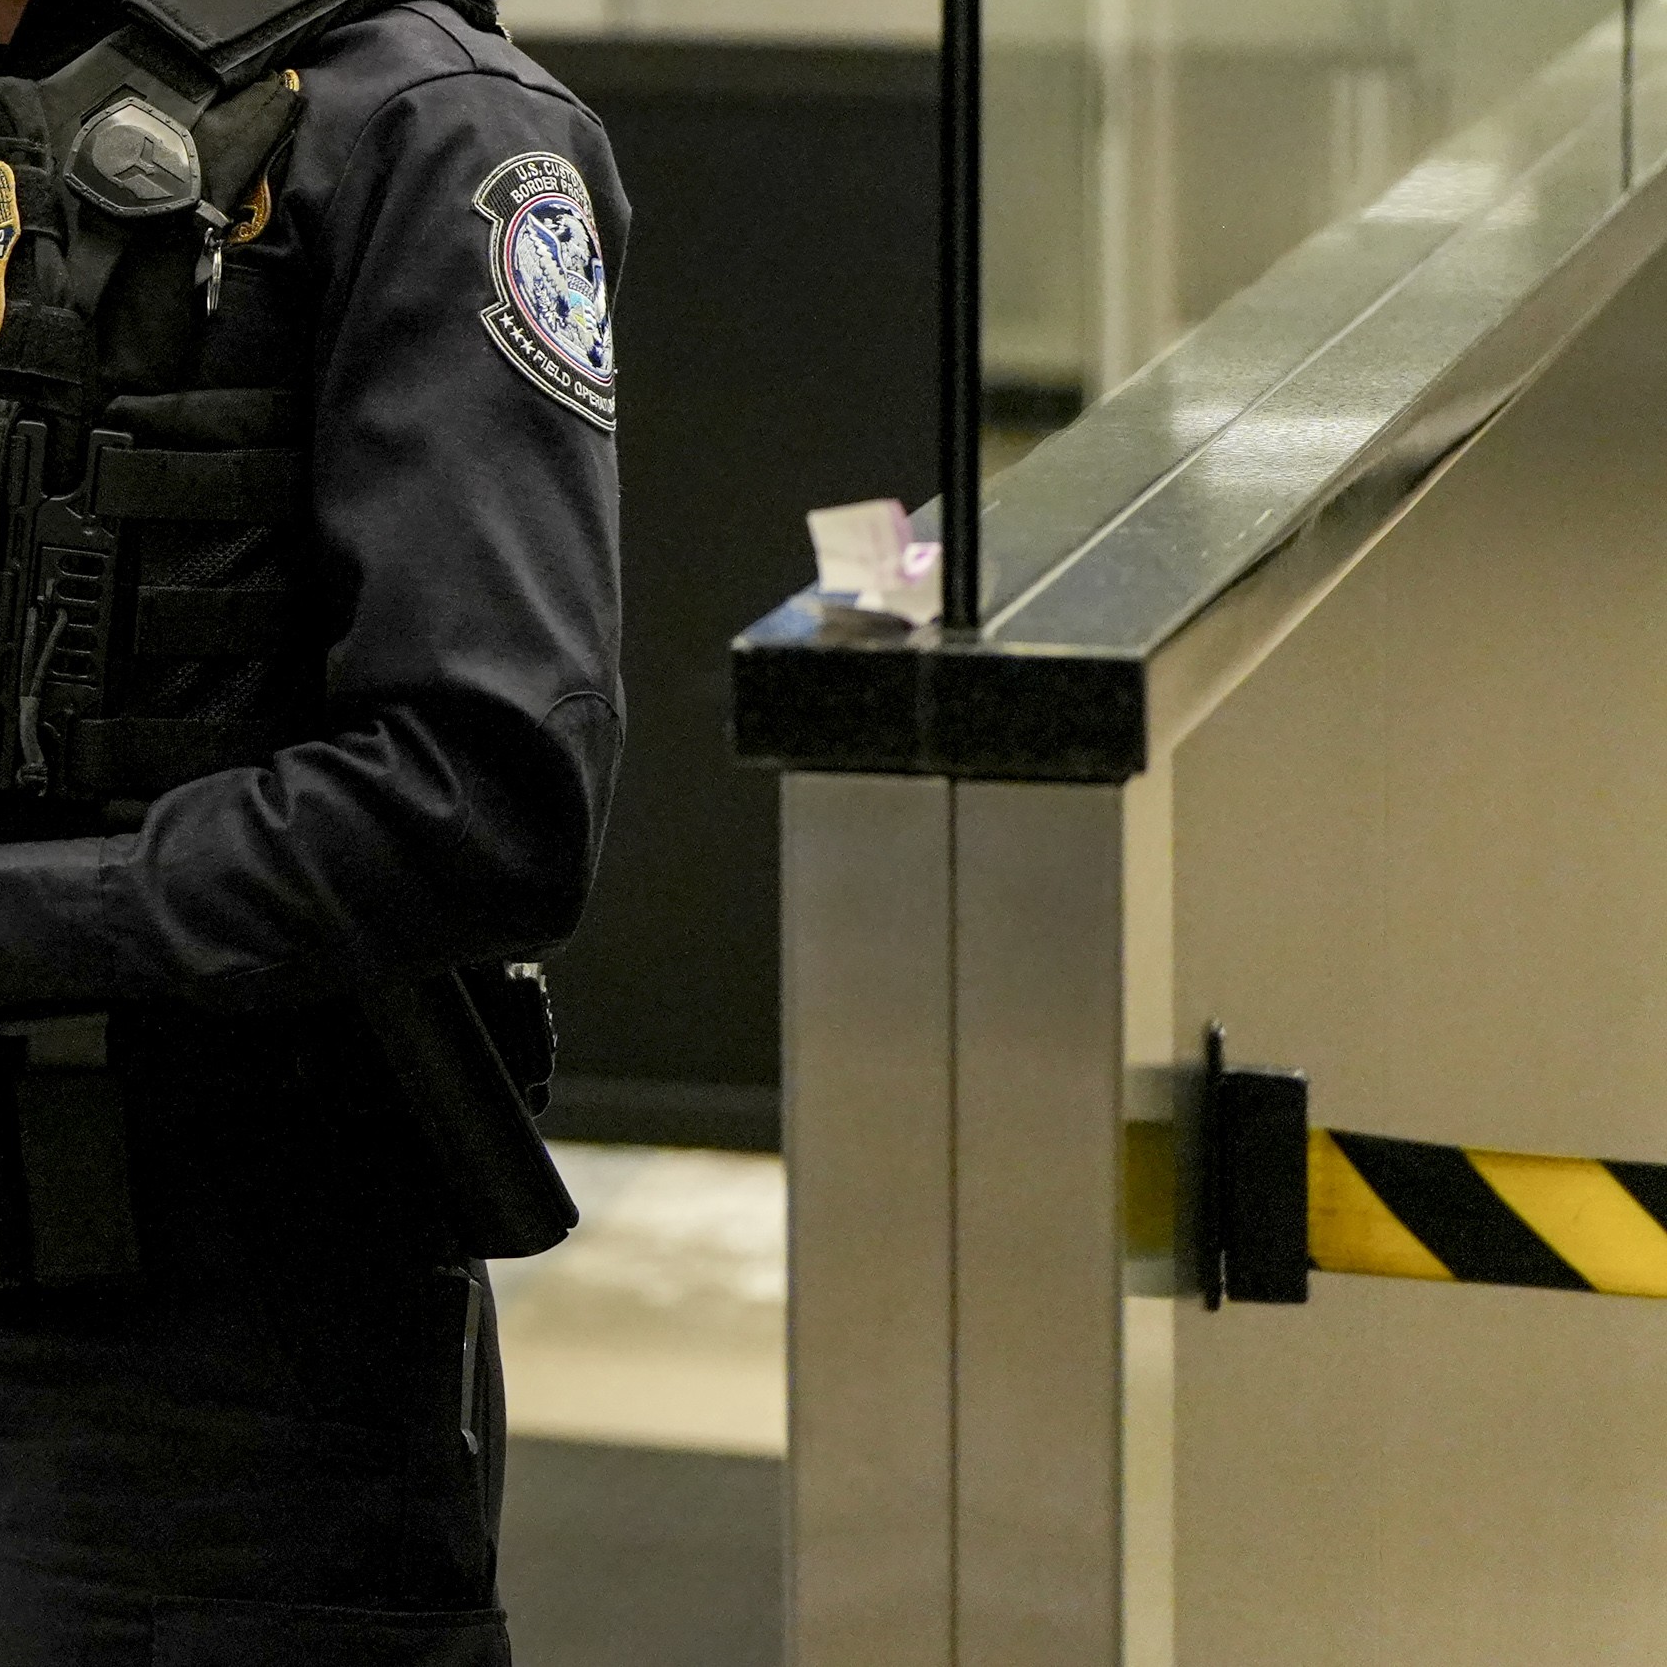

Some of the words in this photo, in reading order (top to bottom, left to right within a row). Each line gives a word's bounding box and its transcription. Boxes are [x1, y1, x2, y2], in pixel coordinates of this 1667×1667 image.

[510, 176, 559, 204] BORDER
[543, 161, 584, 192] CUSTO
[532, 349, 571, 387] FIELD
